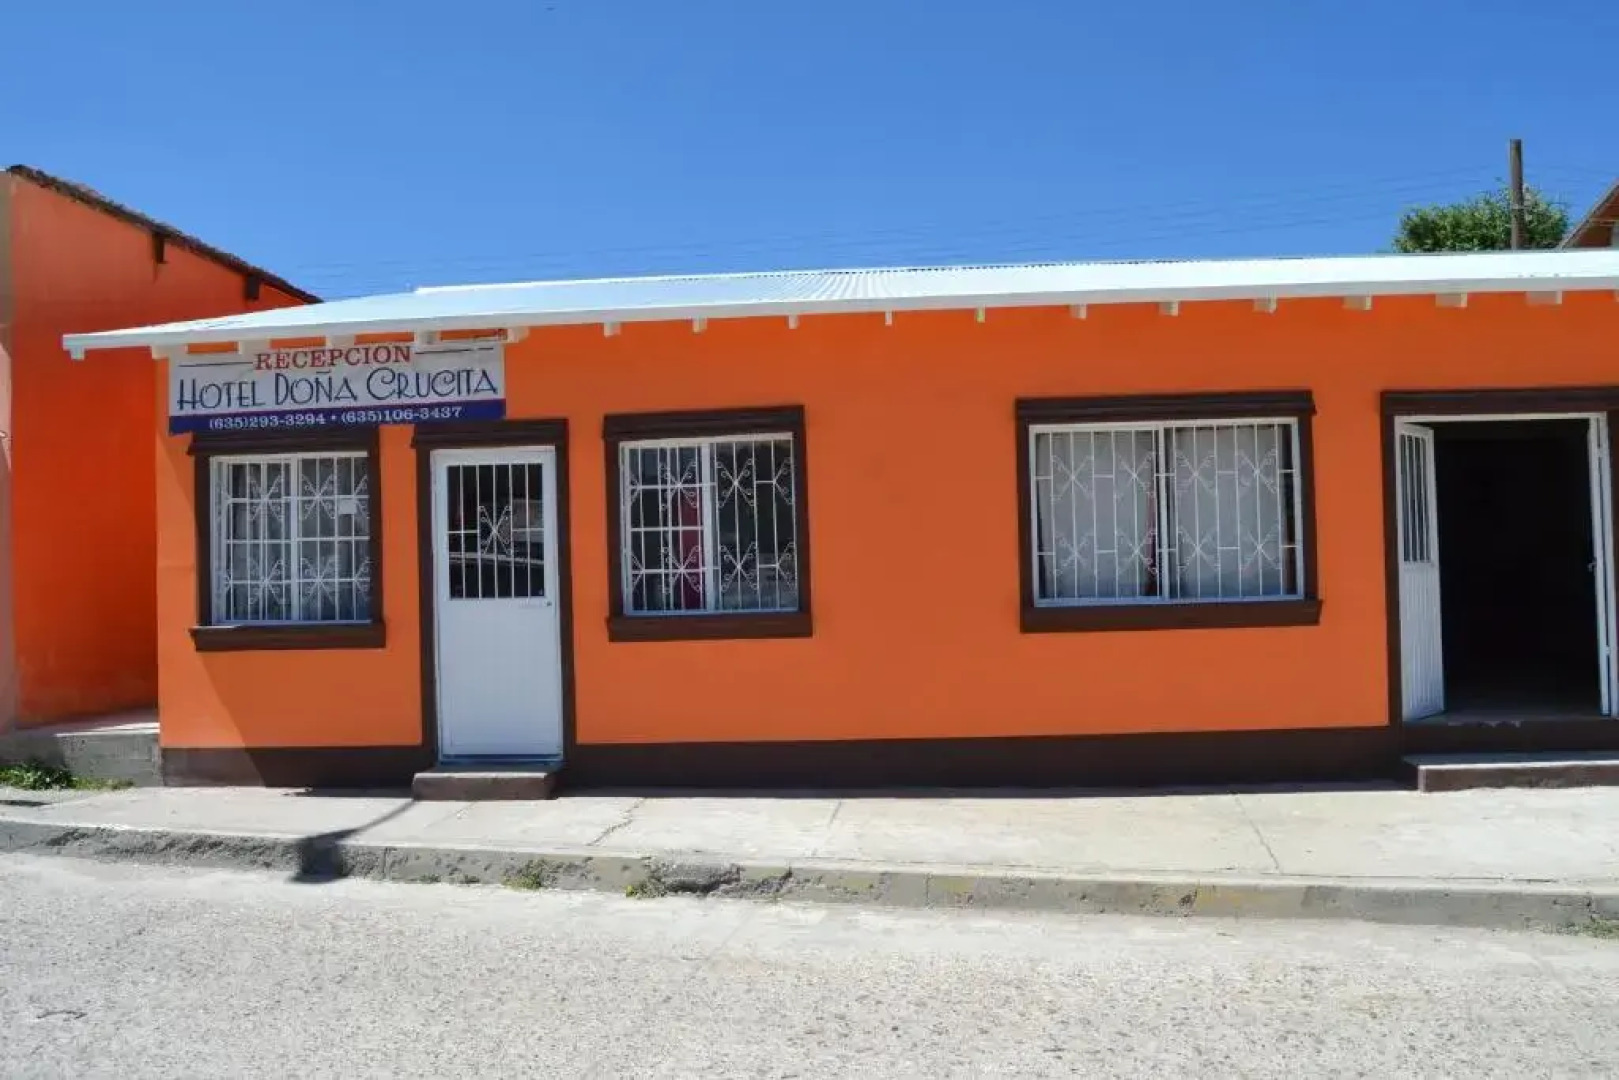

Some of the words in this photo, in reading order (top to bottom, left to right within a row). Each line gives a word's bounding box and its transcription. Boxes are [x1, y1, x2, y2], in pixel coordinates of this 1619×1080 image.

[254, 345, 411, 370] RECEPCION
[177, 378, 266, 411] HOTEL
[274, 370, 358, 405] DOÑA
[366, 367, 498, 401] CRUCITA
